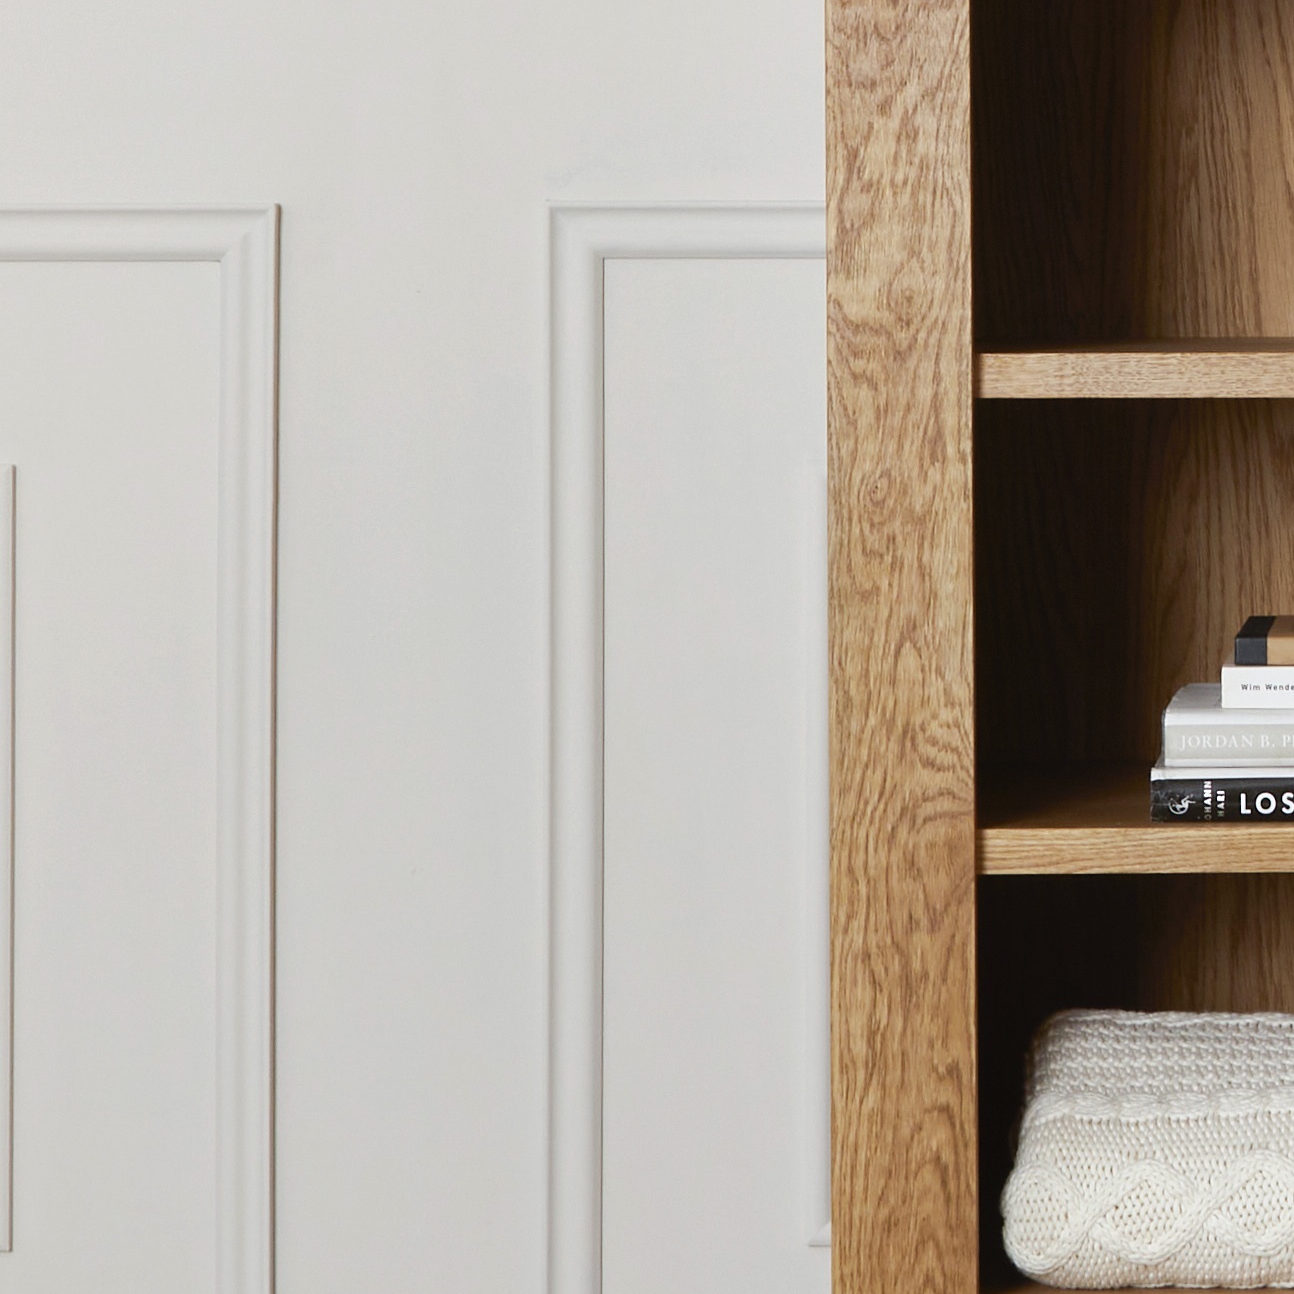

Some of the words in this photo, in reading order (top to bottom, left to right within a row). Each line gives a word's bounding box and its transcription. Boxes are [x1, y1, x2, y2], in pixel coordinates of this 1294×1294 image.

[1240, 683, 1261, 691] Wim
[1178, 734, 1254, 751] JORDAN
[1260, 734, 1275, 748] B.
[1203, 780, 1212, 820] OHANN
[1216, 790, 1226, 817] HARI
